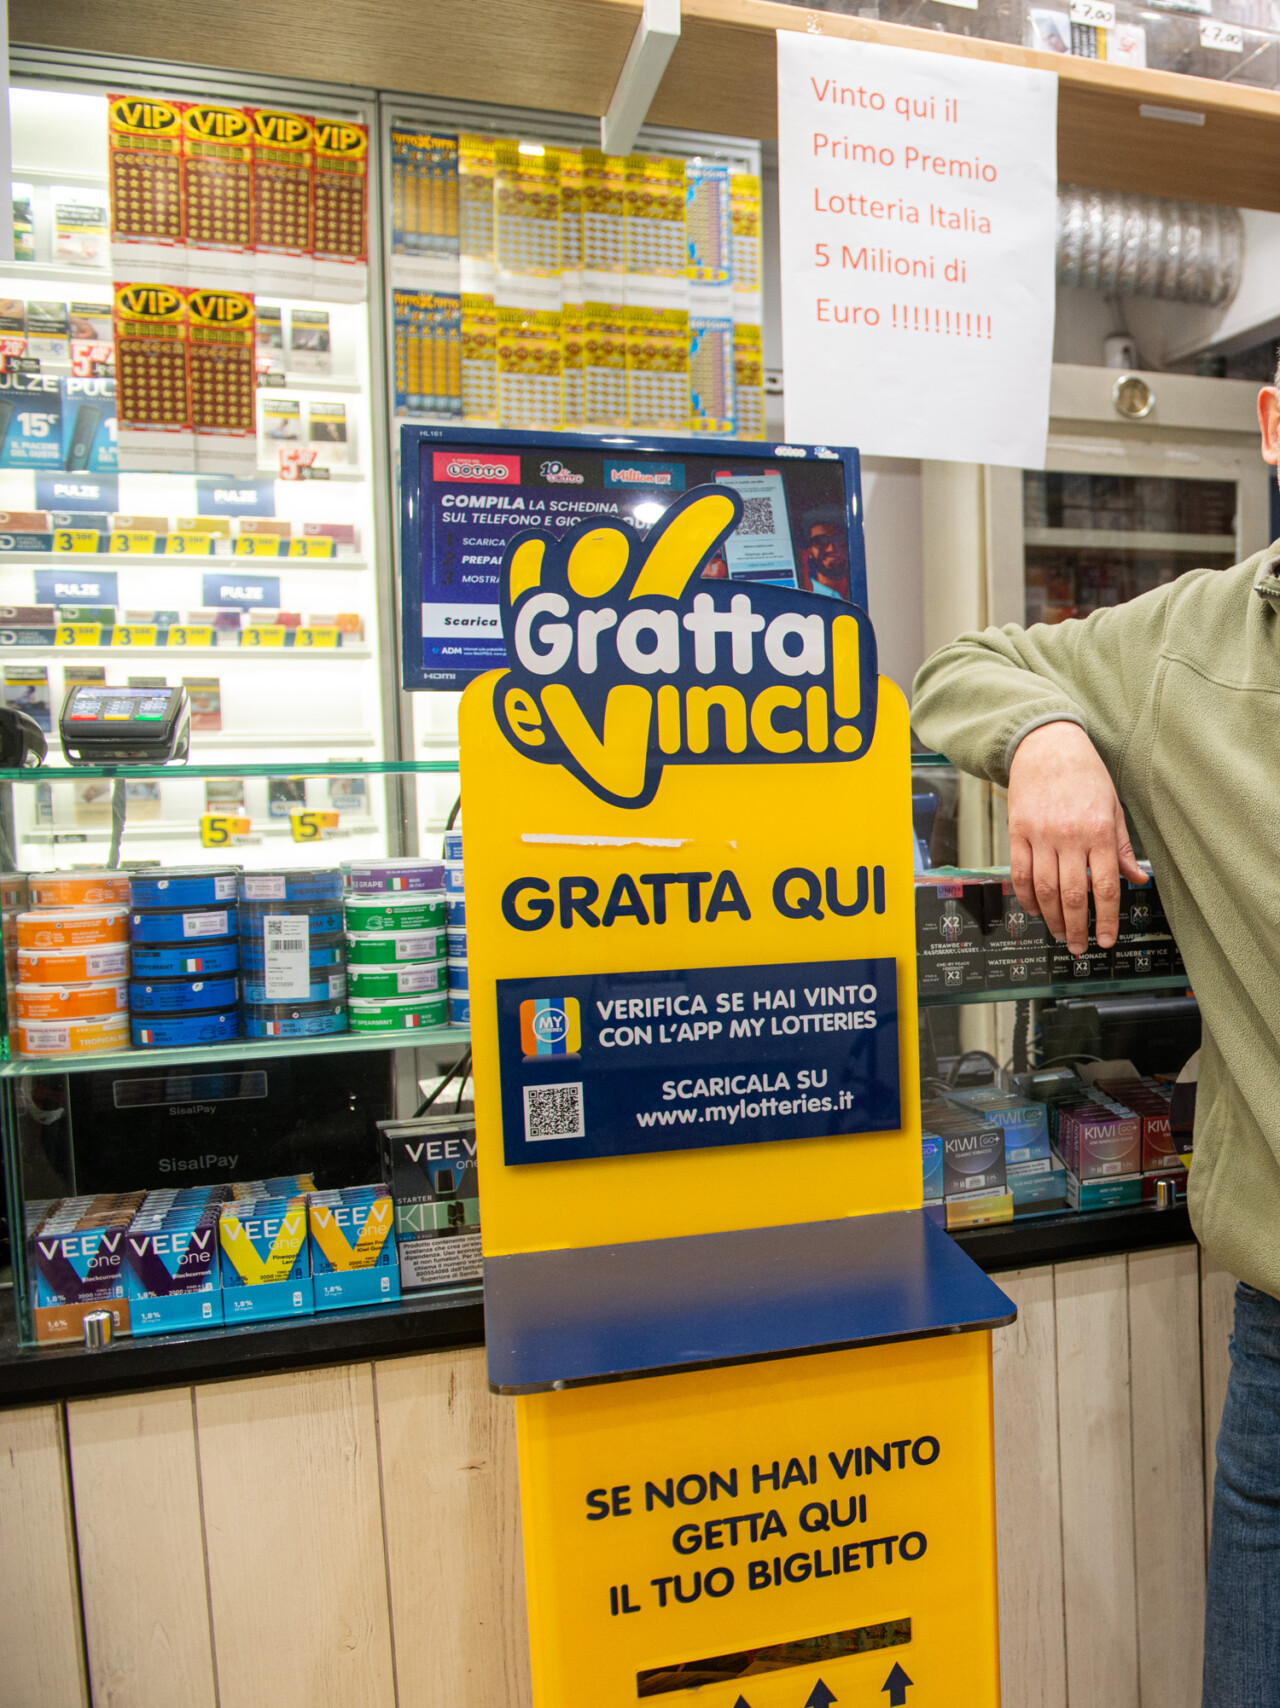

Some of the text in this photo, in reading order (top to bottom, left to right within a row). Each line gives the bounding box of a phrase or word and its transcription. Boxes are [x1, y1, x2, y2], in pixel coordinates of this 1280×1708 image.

[811, 76, 958, 123] Vinto qui il
[121, 103, 176, 128] VIP
[194, 112, 248, 137] VIP
[255, 116, 306, 142] VIP
[314, 124, 358, 151] VIP
[813, 133, 997, 182] Primo Premio
[814, 188, 992, 234] Lotteria Italia
[815, 243, 966, 283] 5 Milioni di
[127, 290, 180, 315] VIP
[198, 298, 248, 321] VIP
[816, 298, 880, 326] Euro
[611, 468, 654, 483] Million
[441, 494, 619, 514] COMPILA LA SCHEDINA
[442, 512, 552, 526] SUL TELEFONO E
[462, 537, 506, 547] SCARICA
[462, 555, 502, 565] PREPA
[444, 616, 498, 626] Scarica
[514, 592, 825, 676] Gratta
[441, 647, 462, 655] ADM
[504, 687, 546, 747] e
[210, 818, 228, 843] 5
[300, 813, 318, 838] 5
[501, 865, 886, 932] GRATTA QUI
[1008, 912, 1025, 924] X2
[1134, 907, 1149, 917] X2
[943, 917, 960, 928] X2
[1012, 966, 1025, 975] X2
[1076, 962, 1088, 970] X2
[1138, 958, 1149, 966] X2
[947, 971, 960, 980] X2
[597, 984, 878, 1021] VERIFICA SE HAI VINTO
[539, 1016, 563, 1030] MY
[598, 1010, 877, 1048] CON L'APP MY LOTTERIES
[79, 1035, 116, 1045] TROPICAL
[662, 1069, 828, 1101] SCARICALA SU
[169, 1104, 217, 1117] SisalPay
[636, 1091, 854, 1129] www.mylotteries.it
[989, 1111, 1021, 1124] KIWI
[1085, 1124, 1115, 1140] KIWI
[405, 1138, 478, 1162] VEEV
[945, 1136, 977, 1153] KIWI
[158, 1154, 239, 1173] SisalPay
[397, 1195, 433, 1204] STARTER
[313, 1204, 388, 1229] VEEV
[398, 1202, 445, 1233] KIT
[223, 1217, 301, 1242] VEEV
[357, 1224, 388, 1238] one
[38, 1232, 122, 1261] VEEV
[129, 1230, 211, 1257] VEEV
[268, 1238, 300, 1251] one
[403, 1236, 466, 1249] Prodotto contenente
[87, 1255, 121, 1268] one
[177, 1252, 211, 1265] one
[420, 1274, 450, 1282] Superiore
[234, 1300, 253, 1308] 1,8%
[47, 1320, 67, 1328] 1,6%
[141, 1312, 161, 1320] 1,8%
[586, 1435, 940, 1522] SE NON HAI VINTO
[672, 1494, 867, 1555] GETTA QUI
[610, 1531, 928, 1616] IL TUO BIGLIETTO
